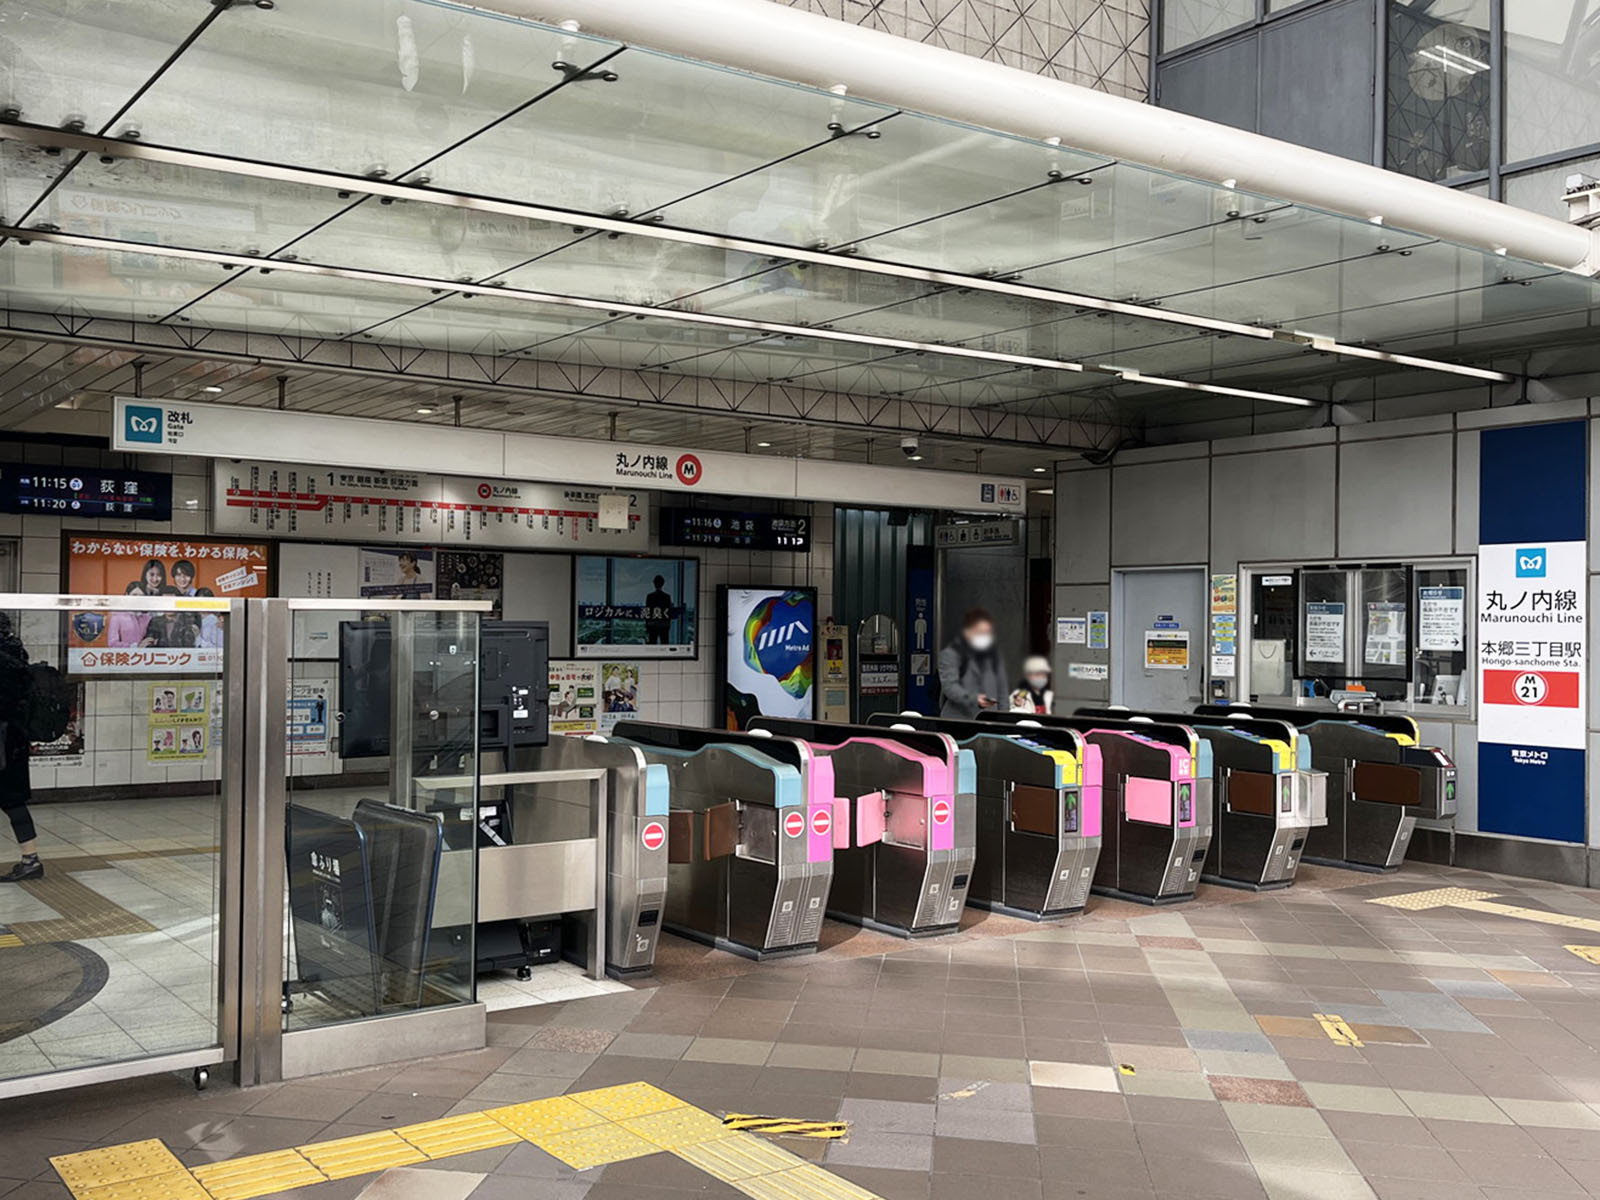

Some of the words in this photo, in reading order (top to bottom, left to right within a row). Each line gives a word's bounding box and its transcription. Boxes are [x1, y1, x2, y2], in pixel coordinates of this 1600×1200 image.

[167, 411, 193, 424] 改札
[616, 453, 668, 471] 丸ノ内線
[616, 468, 657, 479] Marunouchi
[658, 472, 673, 480] Line
[683, 464, 695, 475] M
[327, 472, 334, 486] 1
[33, 476, 67, 489] 11:15
[100, 480, 138, 495] 荻窪
[33, 498, 66, 509] 11:20
[629, 494, 638, 508] 2
[798, 519, 806, 535] 2
[1485, 589, 1578, 612] 丸ノ内線
[1481, 613, 1553, 624] Marunouchi
[1557, 613, 1583, 624] Line
[1481, 641, 1582, 658] 本郷三丁目駅
[100, 651, 191, 667] 保険クリニック
[1482, 658, 1561, 668] Hongo-sanchome
[1563, 659, 1581, 668] Sta.
[1524, 675, 1536, 685] M
[1520, 686, 1538, 698] 21
[1511, 749, 1549, 760] 東京メトロ
[1178, 758, 1190, 769] IC
[1513, 757, 1529, 765] Tokyo
[1529, 758, 1546, 766] Metro
